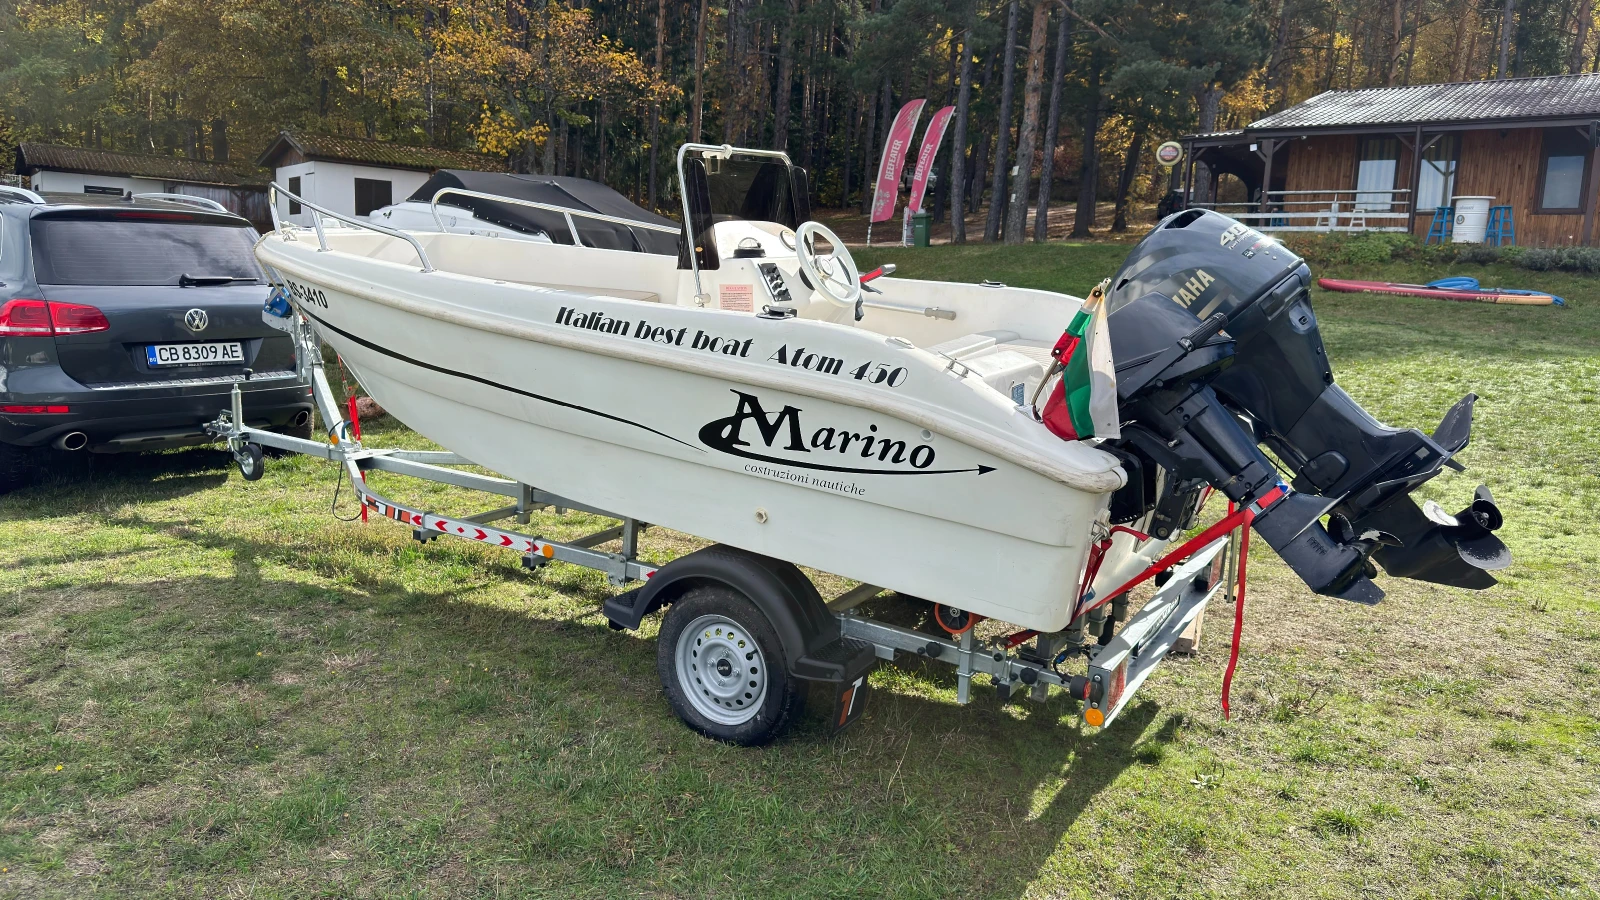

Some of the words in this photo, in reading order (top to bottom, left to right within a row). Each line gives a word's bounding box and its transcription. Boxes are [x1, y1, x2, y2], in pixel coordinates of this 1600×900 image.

[884, 139, 904, 181] BEEFEATER
[914, 143, 934, 182] BEEFEATER
[158, 346, 180, 362] CB
[182, 345, 218, 361] 8309
[222, 344, 240, 359] AE
[555, 306, 631, 337] Italian
[633, 320, 688, 347] best
[691, 329, 754, 358] boat
[767, 343, 844, 375] Atom
[849, 360, 909, 388] 450
[744, 462, 809, 485] costruzioni
[812, 477, 866, 496] nautiche
